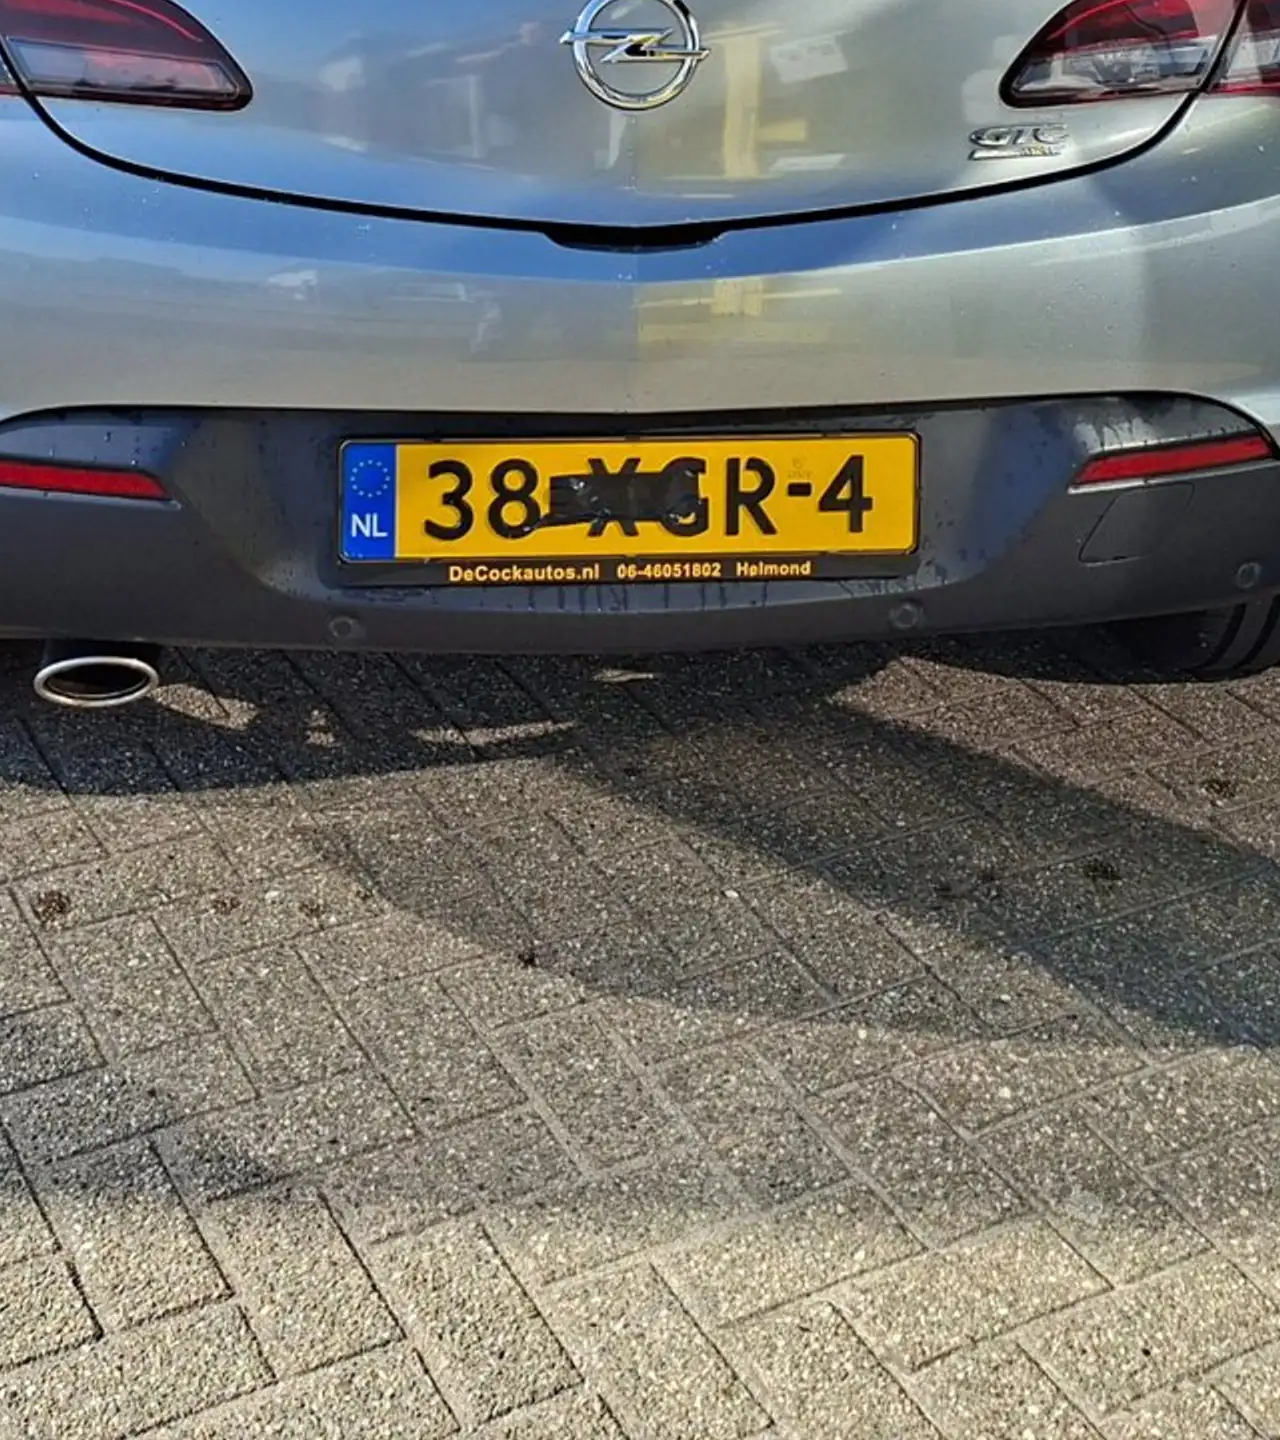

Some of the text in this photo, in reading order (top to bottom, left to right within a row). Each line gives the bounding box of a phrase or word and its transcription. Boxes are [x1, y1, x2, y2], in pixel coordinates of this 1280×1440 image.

[350, 514, 388, 538] NL
[449, 563, 601, 582] DeCockautos.nl
[736, 560, 812, 577] Helmond
